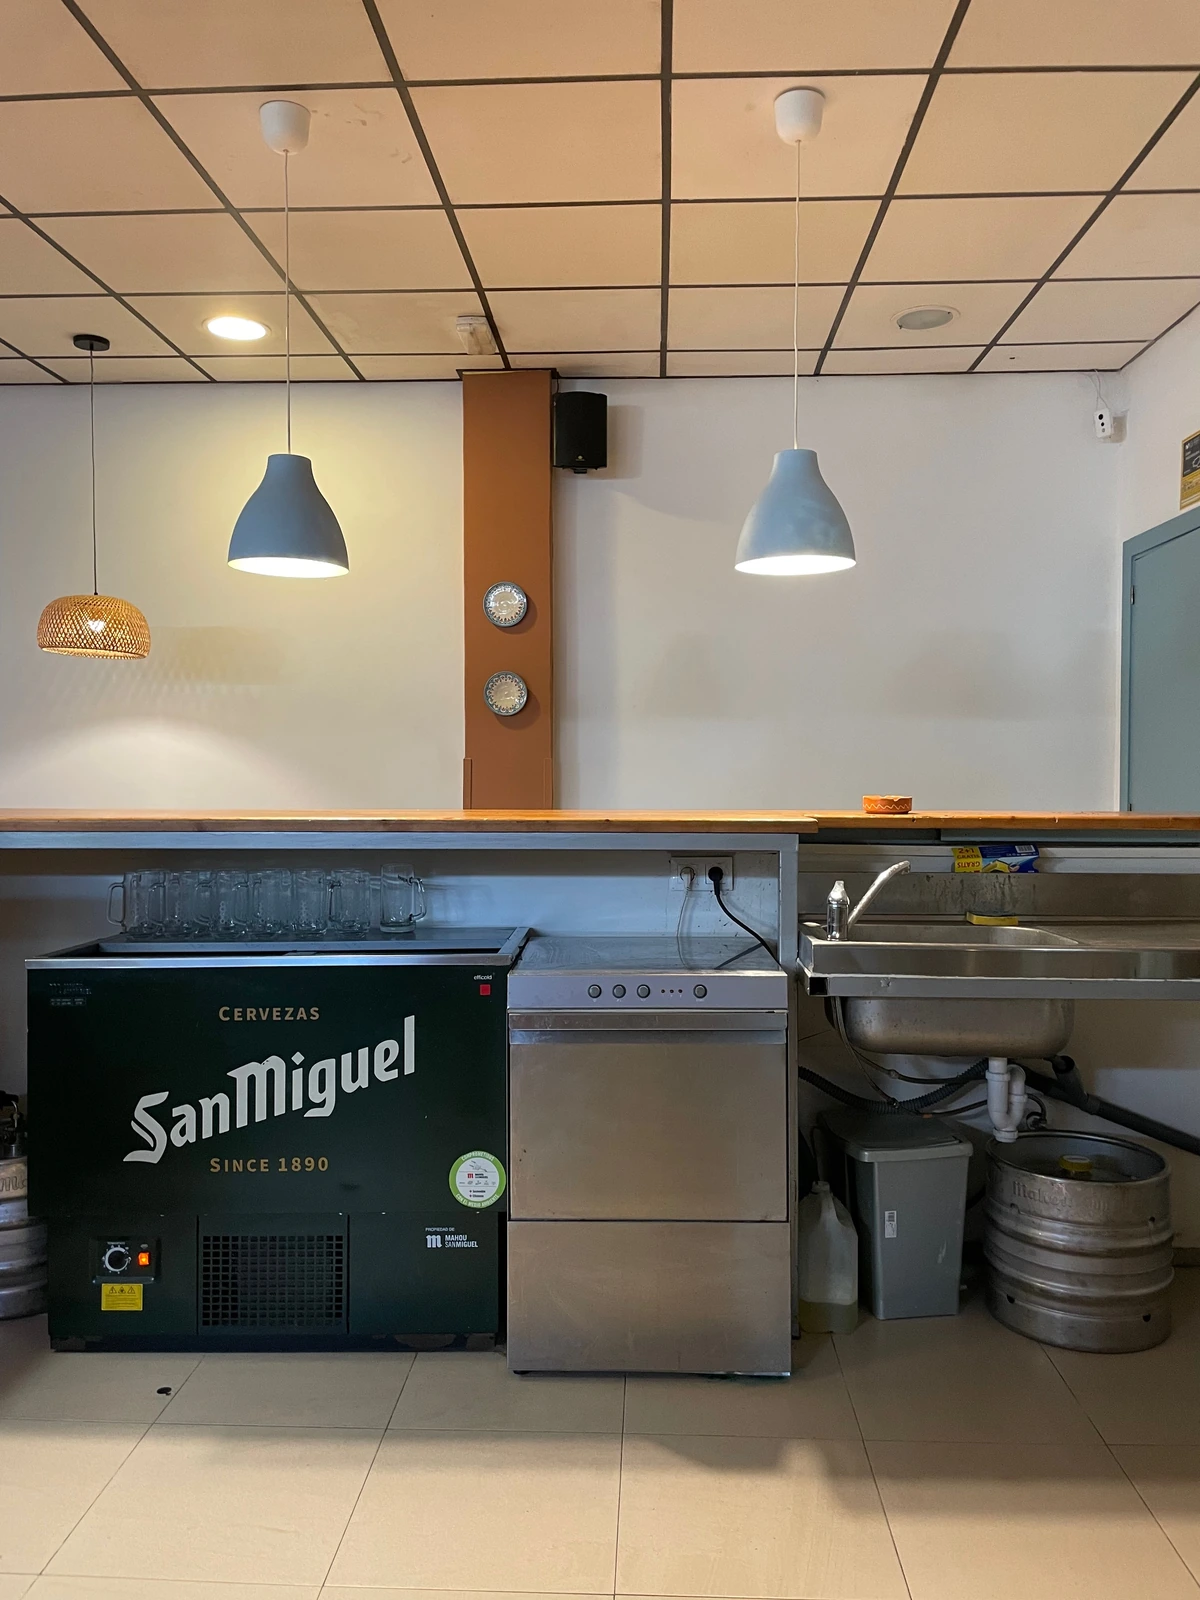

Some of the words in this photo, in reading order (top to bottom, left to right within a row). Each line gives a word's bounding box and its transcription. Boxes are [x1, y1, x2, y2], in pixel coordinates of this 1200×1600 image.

[218, 1006, 321, 1022] CERVEZAS
[209, 1157, 270, 1174] SINCE
[277, 1157, 330, 1173] 1890
